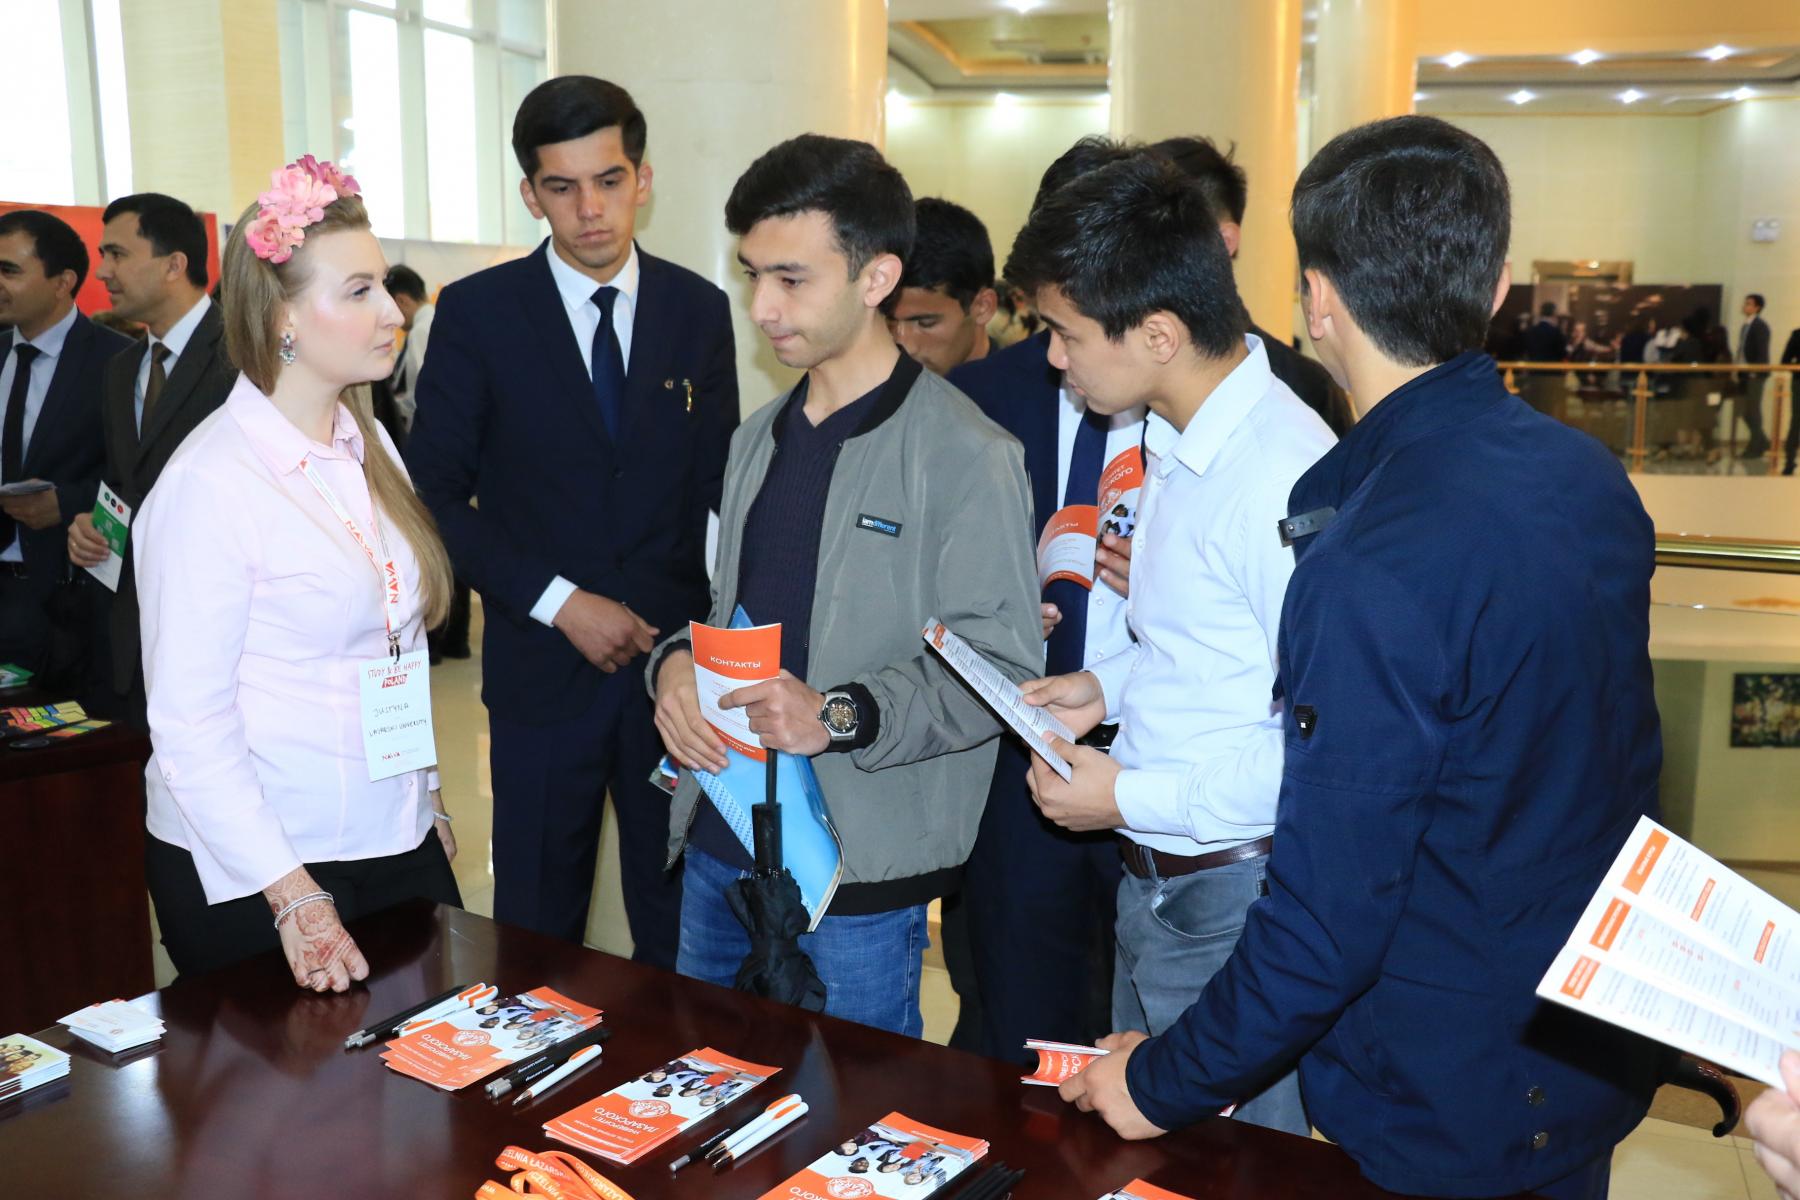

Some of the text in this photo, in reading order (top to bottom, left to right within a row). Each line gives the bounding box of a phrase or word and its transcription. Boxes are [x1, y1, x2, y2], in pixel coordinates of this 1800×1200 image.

[385, 560, 399, 604] NAWA
[710, 655, 761, 669] КОНТАКТЫ
[594, 1107, 660, 1133] ЛАЗАРСКОГО
